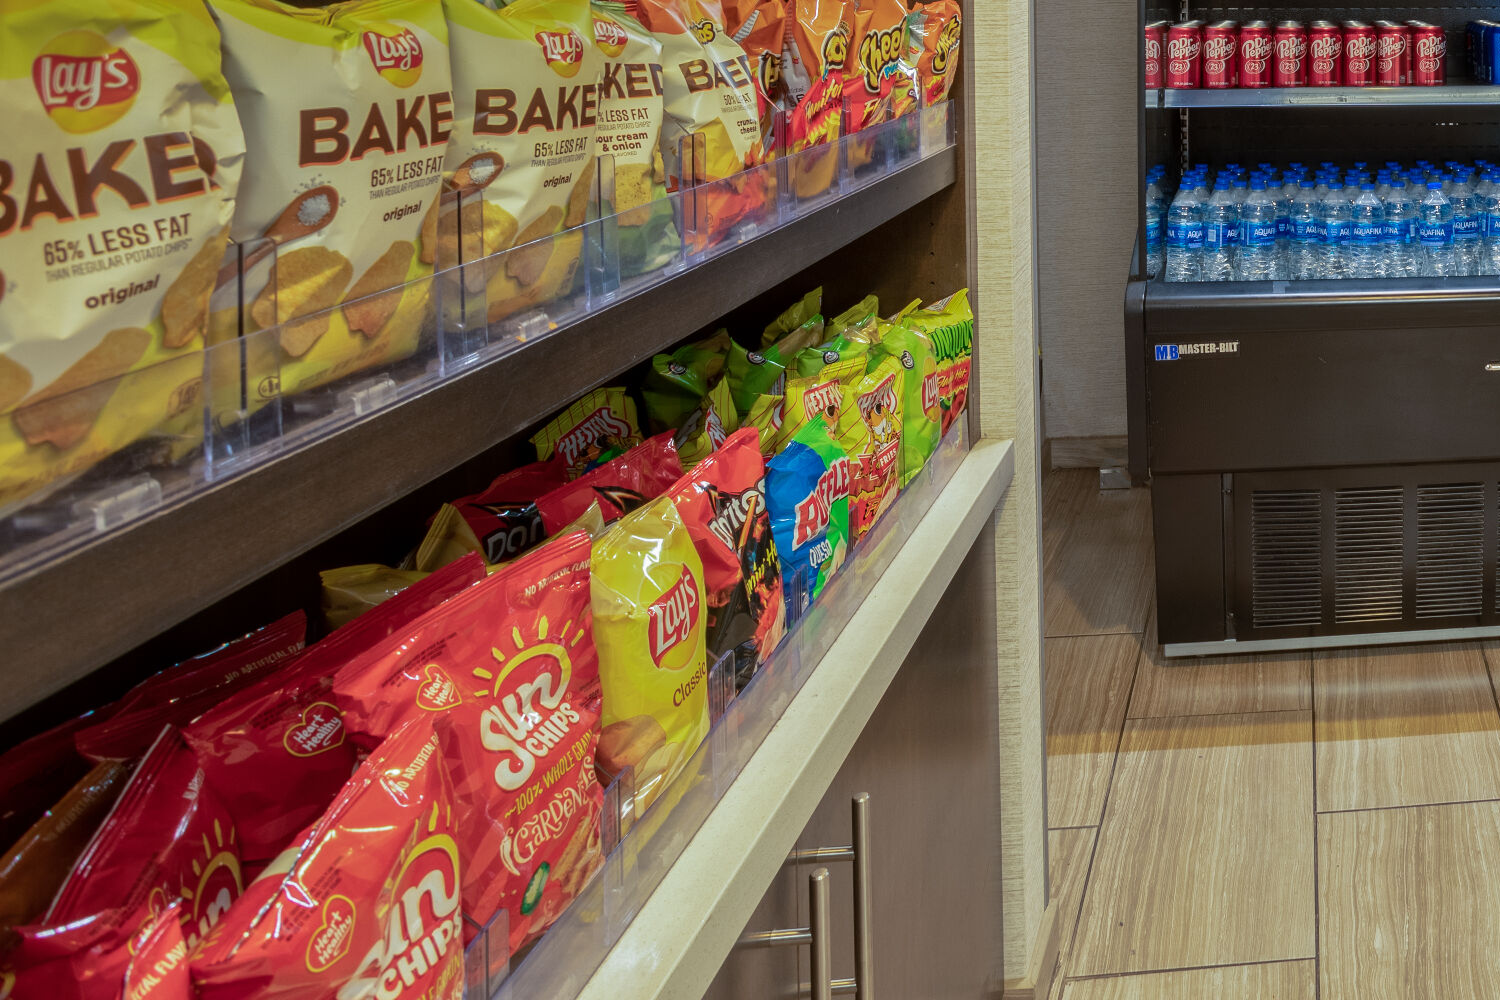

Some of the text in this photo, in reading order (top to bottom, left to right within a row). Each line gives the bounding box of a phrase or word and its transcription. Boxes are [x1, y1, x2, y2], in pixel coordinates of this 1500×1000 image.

[368, 30, 420, 71] Lay's
[42, 56, 130, 111] Lay's
[605, 108, 649, 122] LESS FAT
[534, 136, 588, 158] 65% LESS FAT
[602, 142, 642, 152] & onion
[617, 131, 648, 143] cream
[371, 155, 444, 188] 65% LESS FAT
[543, 173, 572, 188] original
[383, 201, 422, 222] original
[44, 213, 191, 267] 65% LESS FAT
[72, 256, 124, 277] REGULAR
[85, 274, 160, 309] original
[1179, 341, 1239, 355] MASTER-BILT
[879, 447, 898, 468] FRIES
[809, 539, 833, 568] QUESO
[650, 572, 697, 659] Lay's
[423, 673, 444, 699] Heart
[672, 660, 707, 708] Classic
[293, 713, 323, 744] Heart
[480, 671, 554, 792] Sun
[526, 702, 580, 757] CHIPS
[515, 782, 544, 810] 100%
[543, 755, 576, 787] WHOLE
[314, 910, 342, 952] Heart
